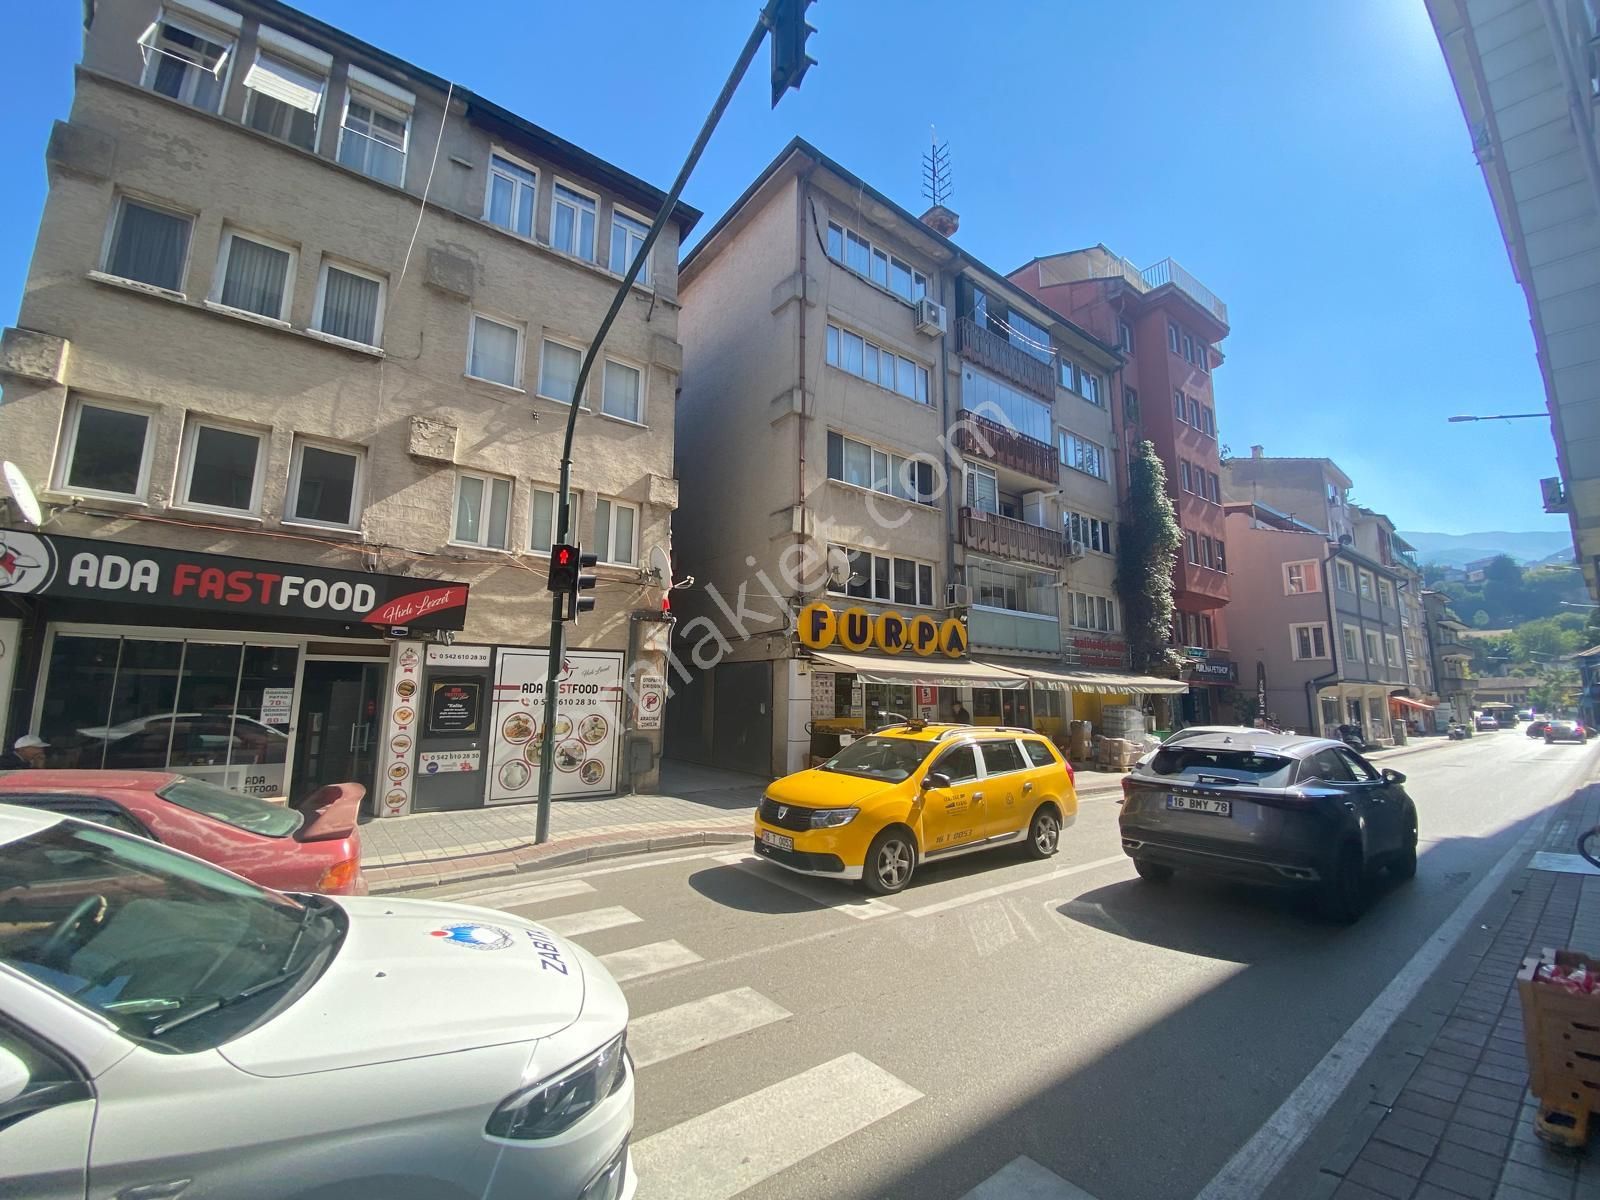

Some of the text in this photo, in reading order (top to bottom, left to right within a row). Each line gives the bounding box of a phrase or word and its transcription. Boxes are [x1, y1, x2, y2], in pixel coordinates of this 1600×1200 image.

[68, 553, 376, 613] ADA FASTFOOD
[811, 609, 965, 652] FURPA
[521, 683, 599, 694] ADA STFOOD
[558, 698, 573, 706] 610
[575, 698, 585, 706] 28
[587, 698, 597, 706] 30
[245, 776, 266, 785] ADA
[1174, 797, 1228, 813] 16 BMY 78
